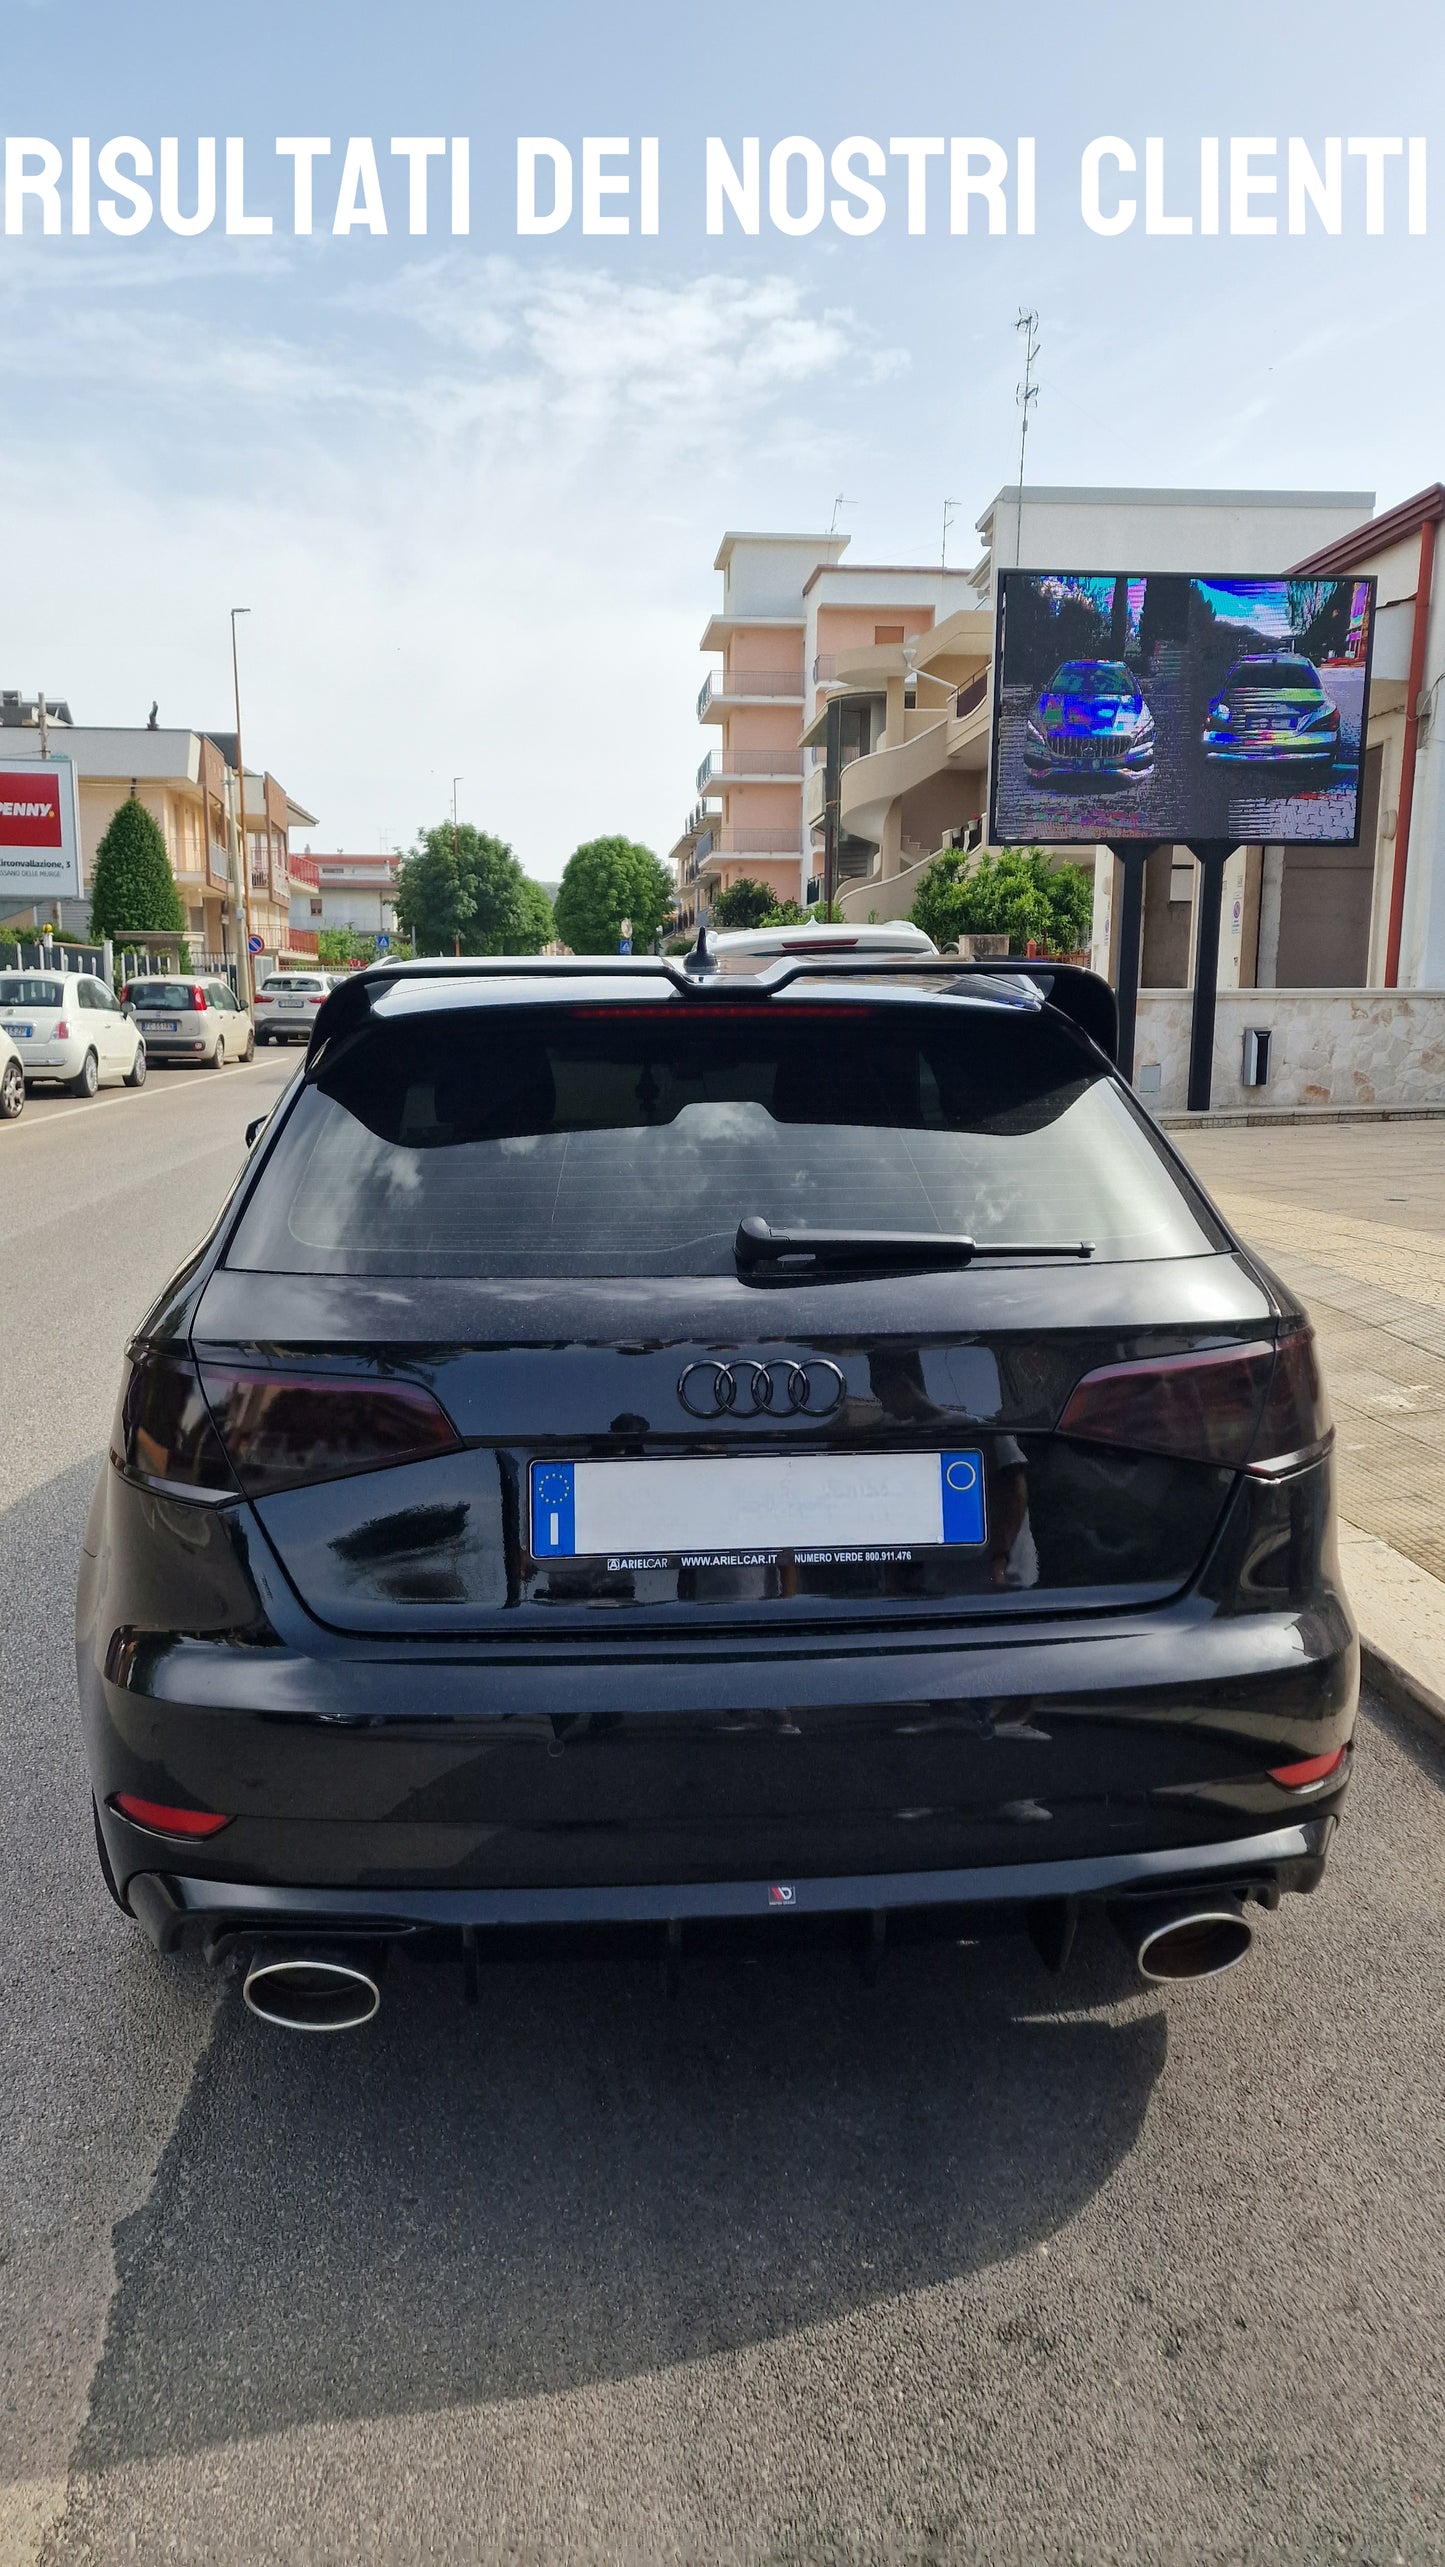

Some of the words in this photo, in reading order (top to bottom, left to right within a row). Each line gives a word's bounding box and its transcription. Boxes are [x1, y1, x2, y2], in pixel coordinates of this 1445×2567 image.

[0, 858, 64, 869] irconvallazione,
[620, 1558, 668, 1570] ARIELCAR
[681, 1555, 777, 1567] WWW.ARIELCAR.IT
[794, 1553, 832, 1563] NUMERO
[834, 1552, 863, 1562] VERDE
[865, 1551, 912, 1561] 800.911.476
